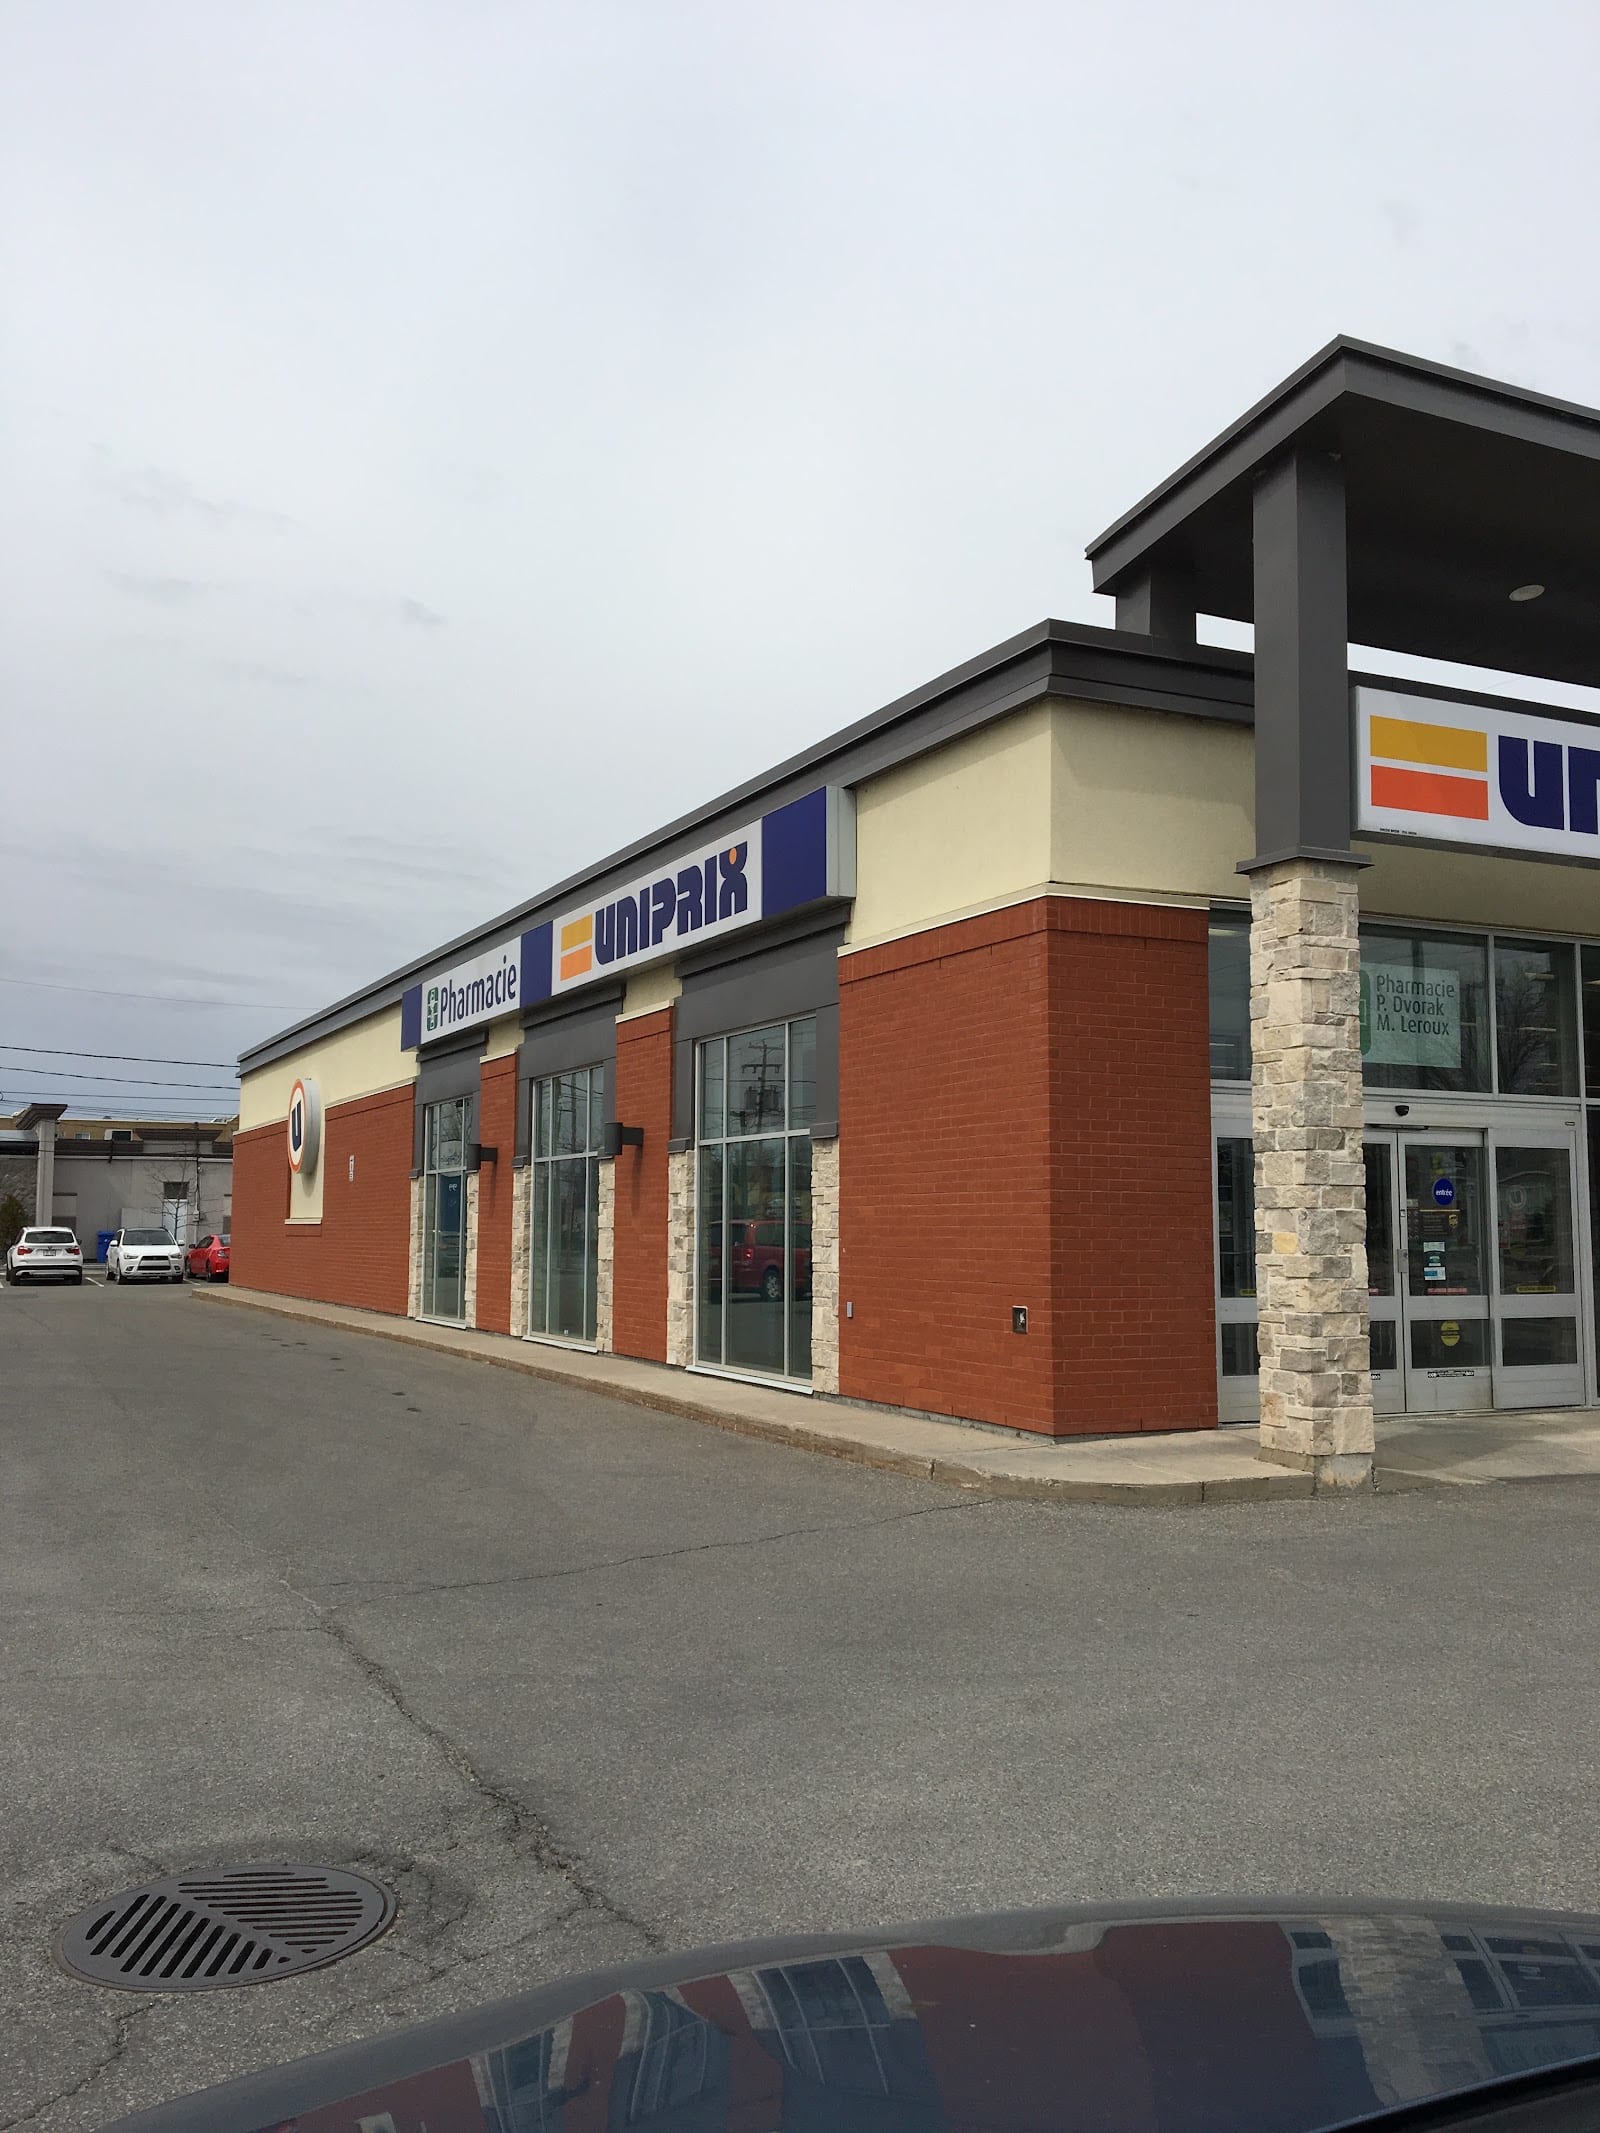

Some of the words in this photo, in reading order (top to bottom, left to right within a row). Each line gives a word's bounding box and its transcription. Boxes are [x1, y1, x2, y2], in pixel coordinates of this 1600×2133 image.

[440, 954, 517, 1027] Pharmacie
[595, 841, 748, 966] UNIPRIX
[1376, 974, 1455, 998] Pharmacie
[1376, 995, 1388, 1012] P.
[1393, 996, 1445, 1016] Dvorak
[1376, 1014, 1396, 1032] M.
[1400, 1016, 1450, 1036] Leroux
[291, 1100, 302, 1152] U
